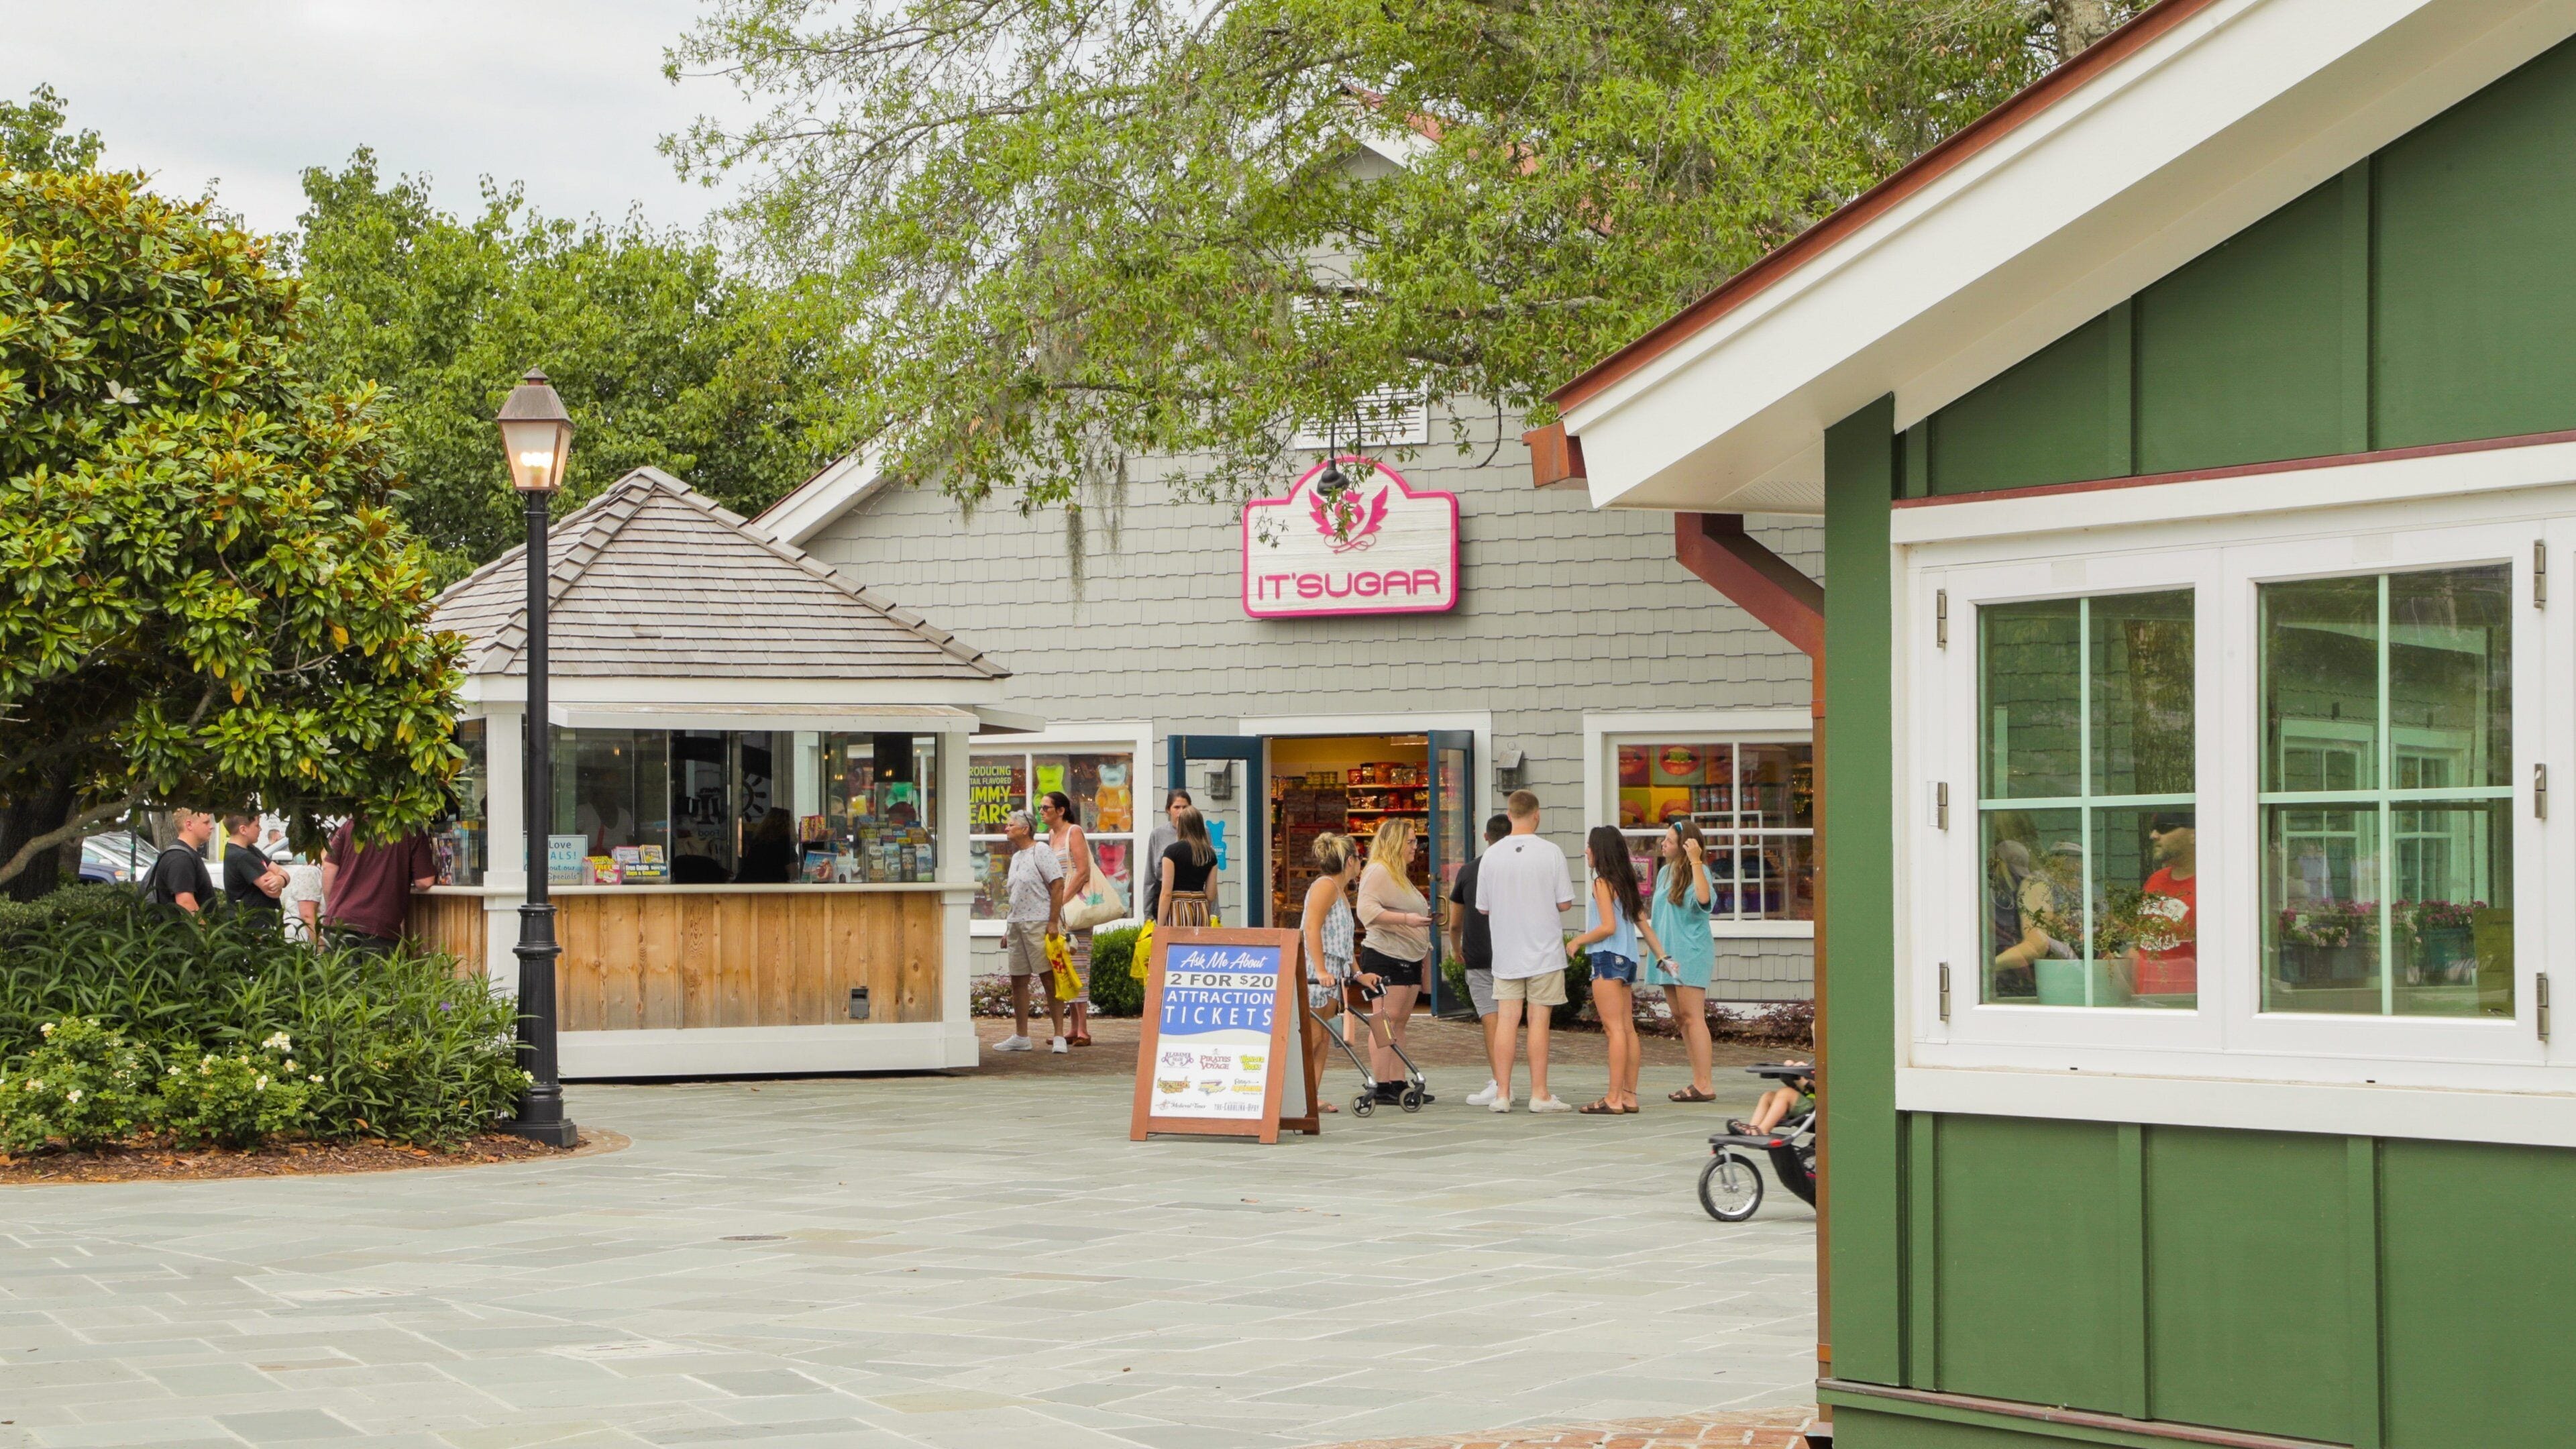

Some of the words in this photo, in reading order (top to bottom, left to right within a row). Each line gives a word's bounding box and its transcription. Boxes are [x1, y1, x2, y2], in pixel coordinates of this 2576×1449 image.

[1258, 569, 1441, 600] IT'SUGAR
[982, 777, 1012, 785] FLAVORED
[549, 841, 572, 849] Love
[550, 851, 578, 860] ALS!
[1180, 951, 1205, 969] Ask
[1206, 951, 1228, 969] Me
[1229, 952, 1268, 969] About
[1171, 973, 1182, 985] 2
[1190, 974, 1232, 987] FOR
[1240, 975, 1273, 988] $20
[1167, 990, 1273, 1005] ATTRACTION
[1165, 1006, 1272, 1026] TICKETS
[1200, 1055, 1232, 1064] PIRATES
[1201, 1062, 1229, 1070] VOYAGE
